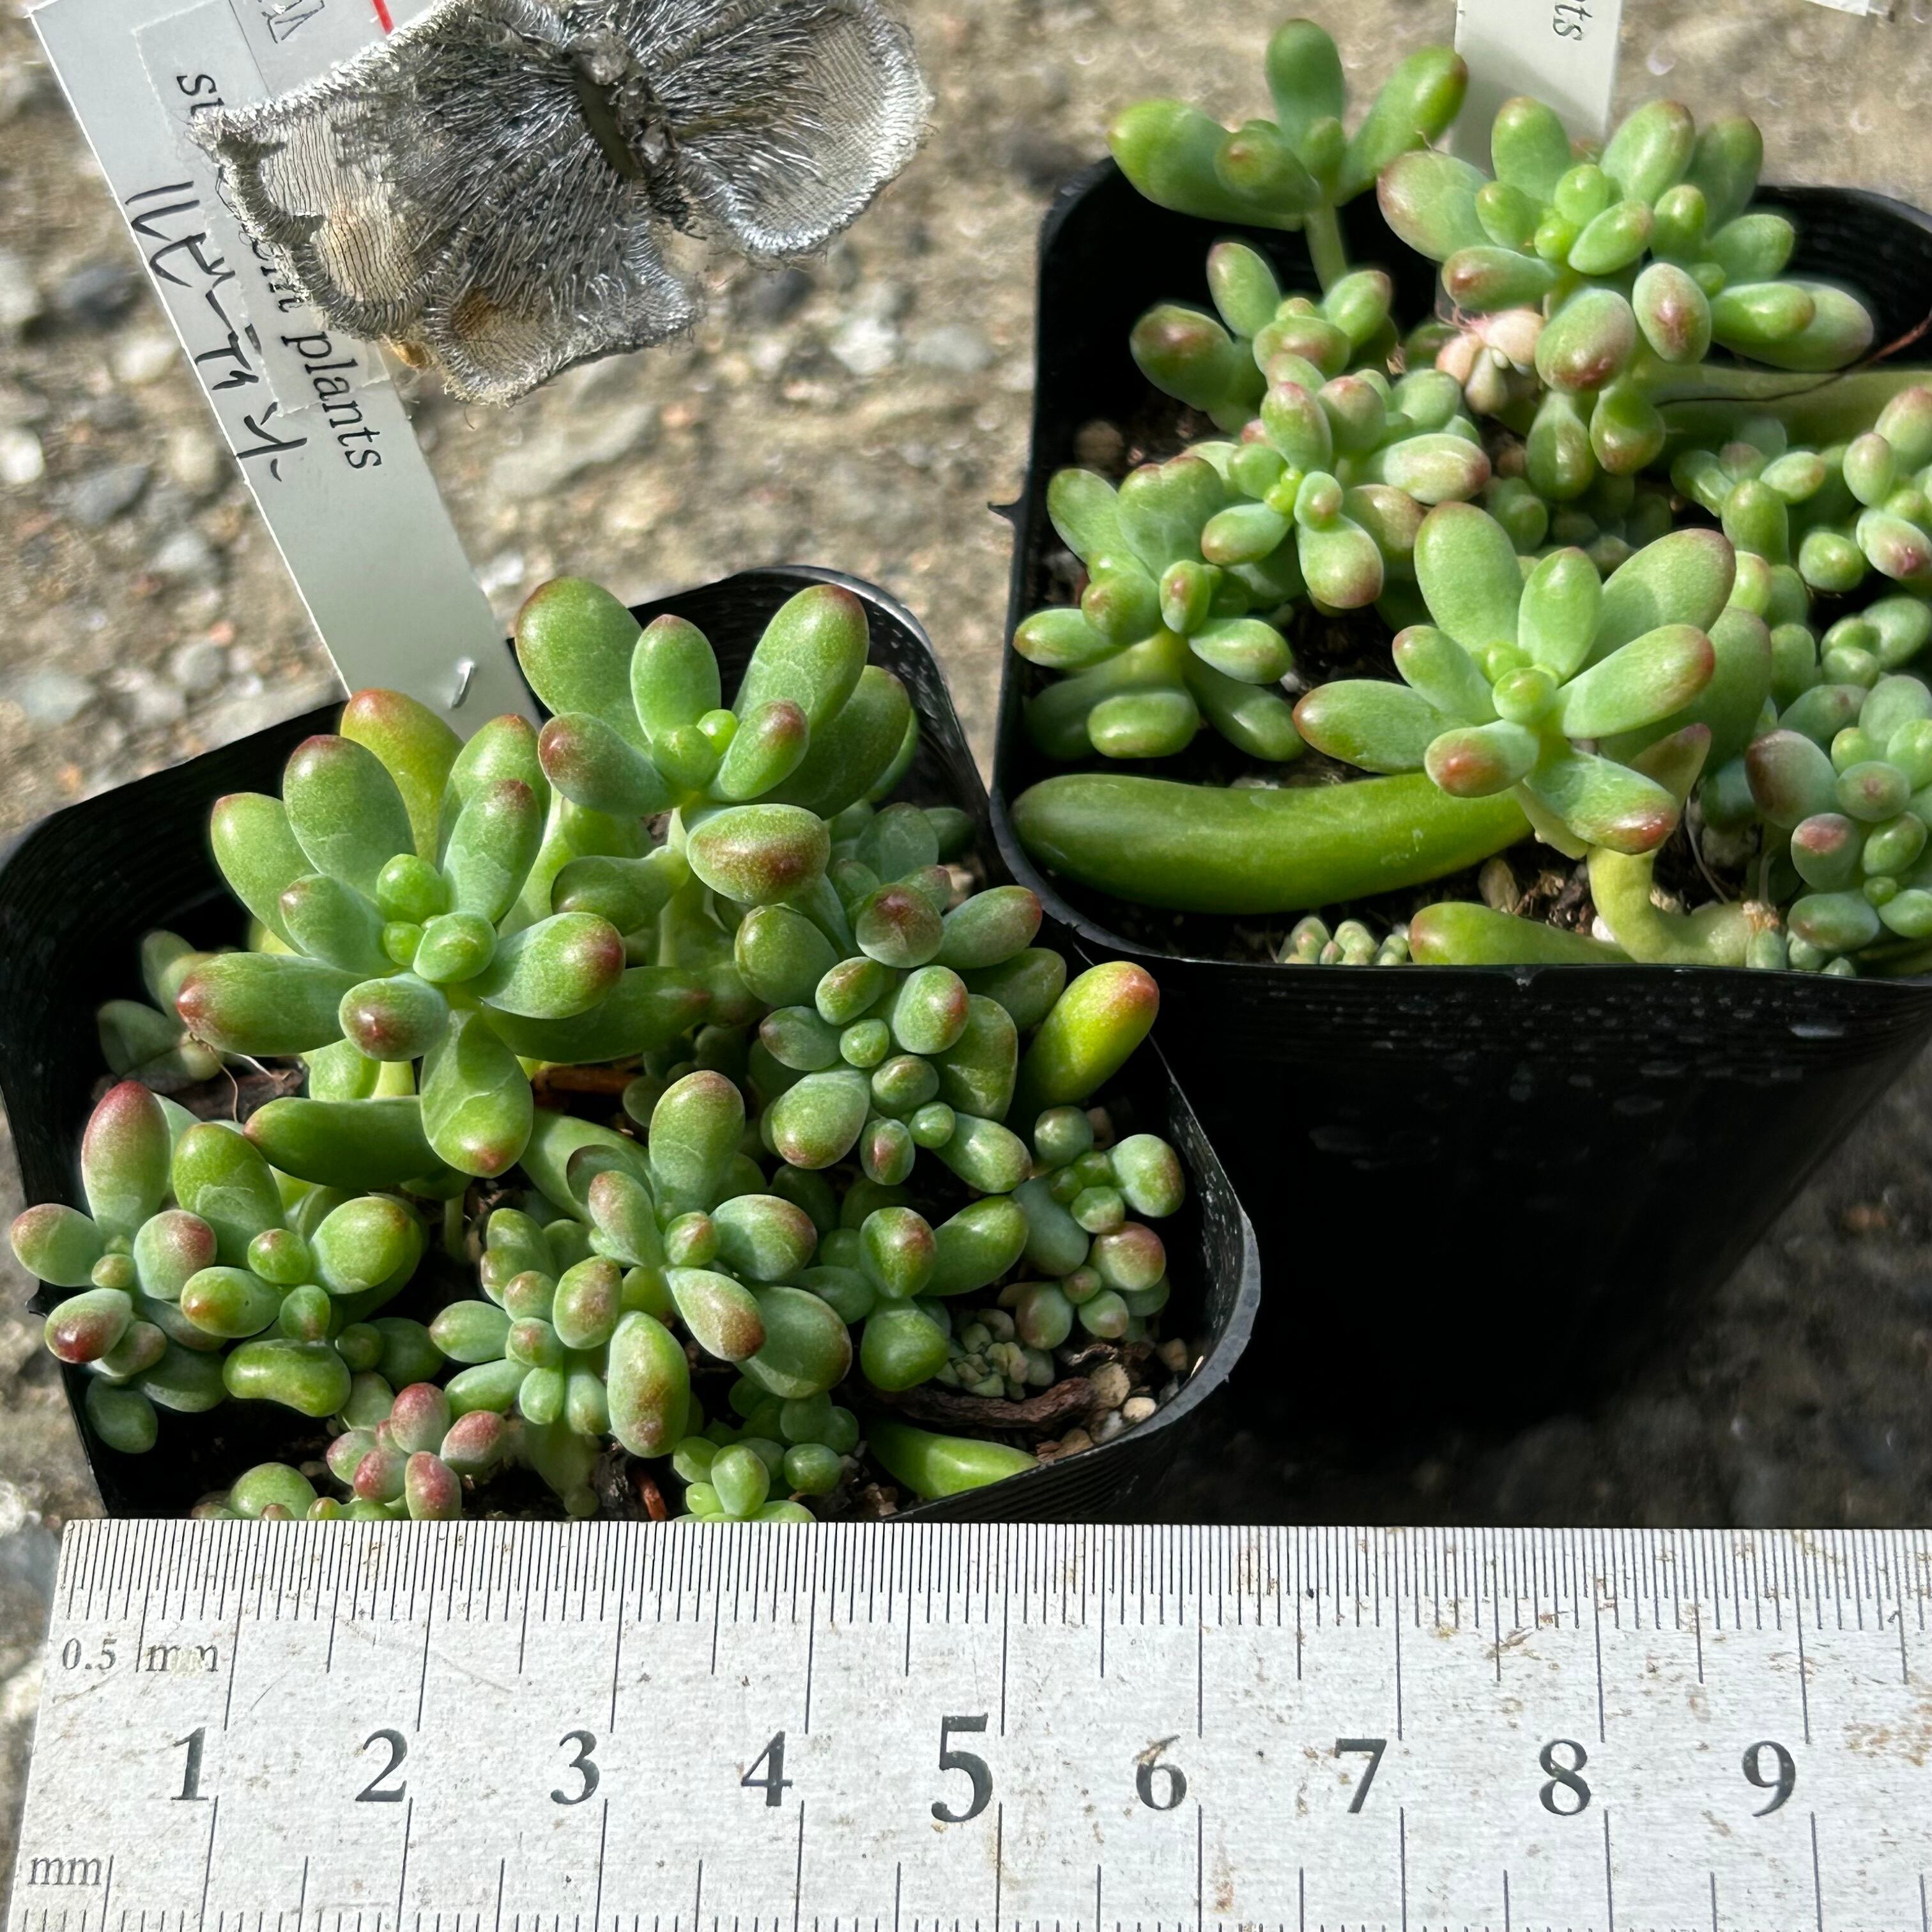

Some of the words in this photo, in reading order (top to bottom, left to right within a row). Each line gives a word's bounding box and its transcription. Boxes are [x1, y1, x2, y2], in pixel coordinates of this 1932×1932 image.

[1552, 0, 1593, 41] ts
[280, 330, 383, 470] plants
[63, 1637, 118, 1670] 0.5
[169, 1726, 209, 1800] 1
[355, 1728, 408, 1802] 2
[550, 1729, 600, 1805] 3
[740, 1730, 793, 1806] 4
[931, 1712, 993, 1823] 5
[1134, 1735, 1188, 1811] 6
[1334, 1738, 1388, 1813] 7
[1538, 1738, 1591, 1816] 8
[1742, 1740, 1797, 1817] 9
[26, 1855, 103, 1886] mm
